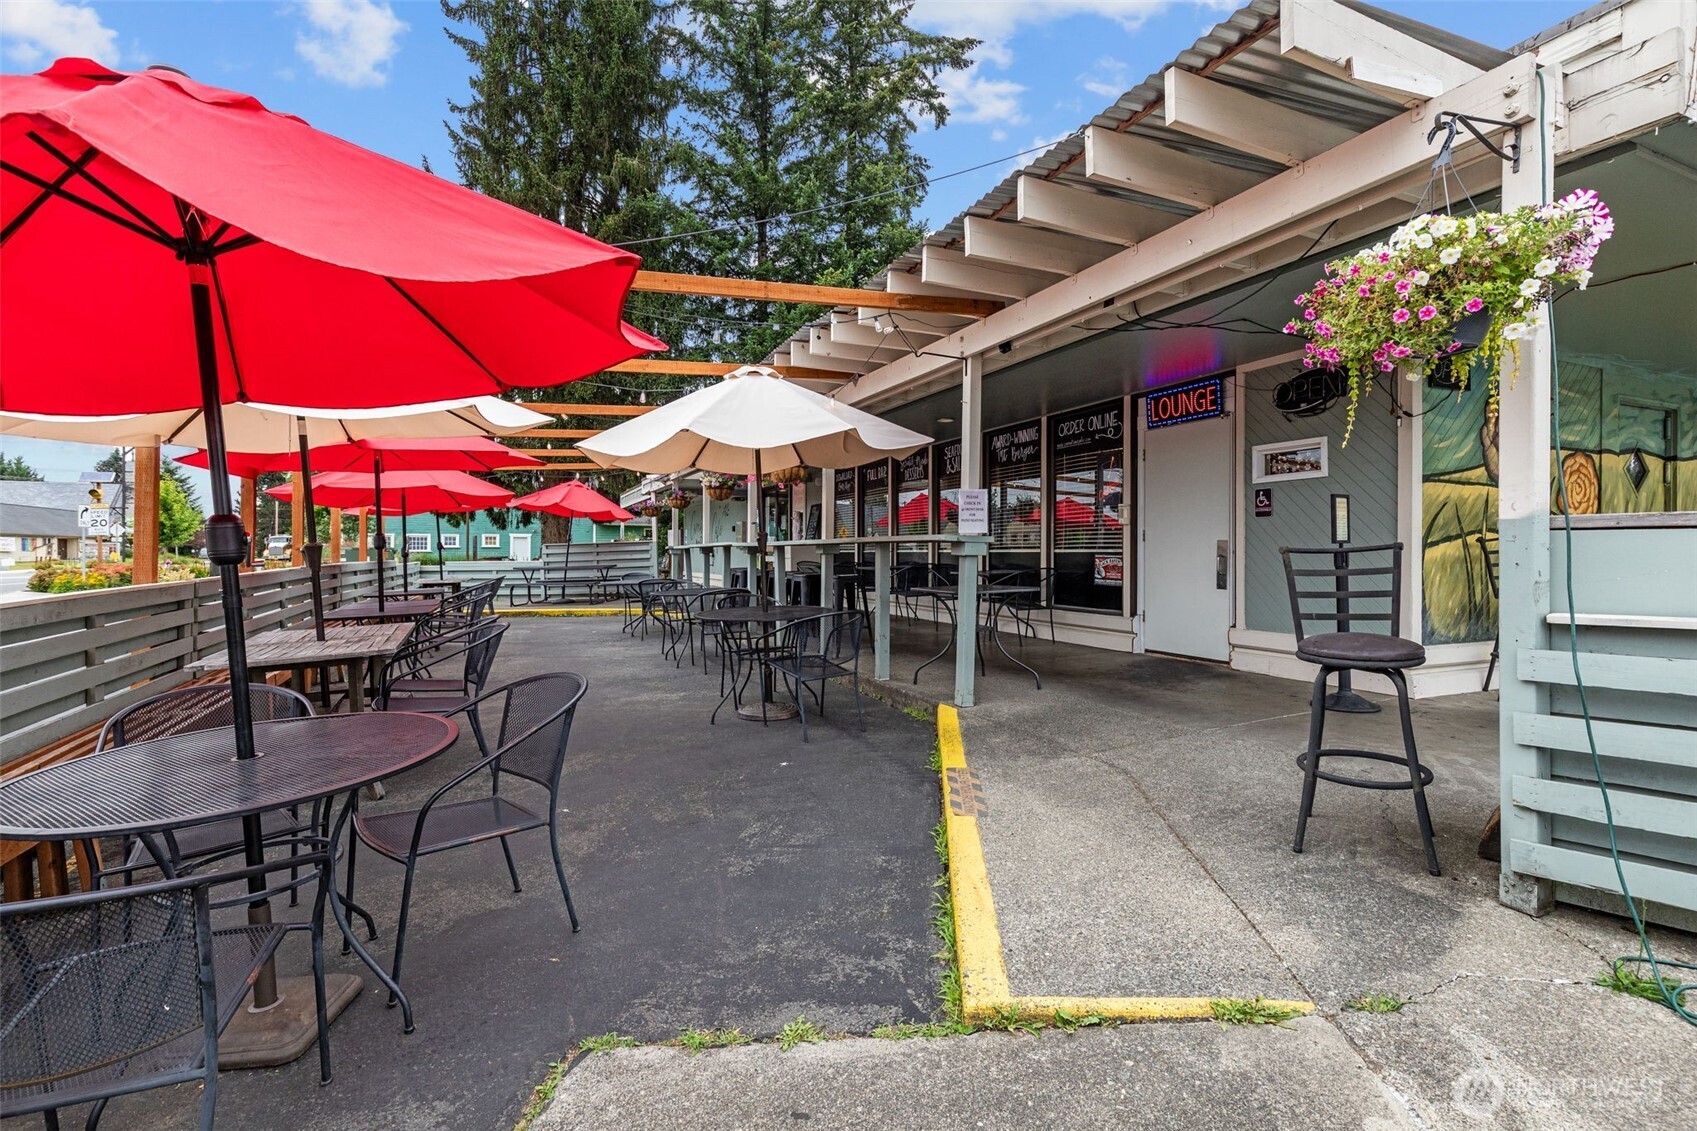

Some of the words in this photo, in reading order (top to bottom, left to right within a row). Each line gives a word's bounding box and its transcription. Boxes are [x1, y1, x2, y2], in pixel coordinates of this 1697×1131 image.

[1274, 373, 1341, 403] OPEN
[1151, 386, 1217, 421] LOUNGE
[1058, 418, 1085, 437] ORDER
[1088, 410, 1118, 431] ONLINE
[866, 469, 877, 481] FULL
[91, 519, 108, 527] 20
